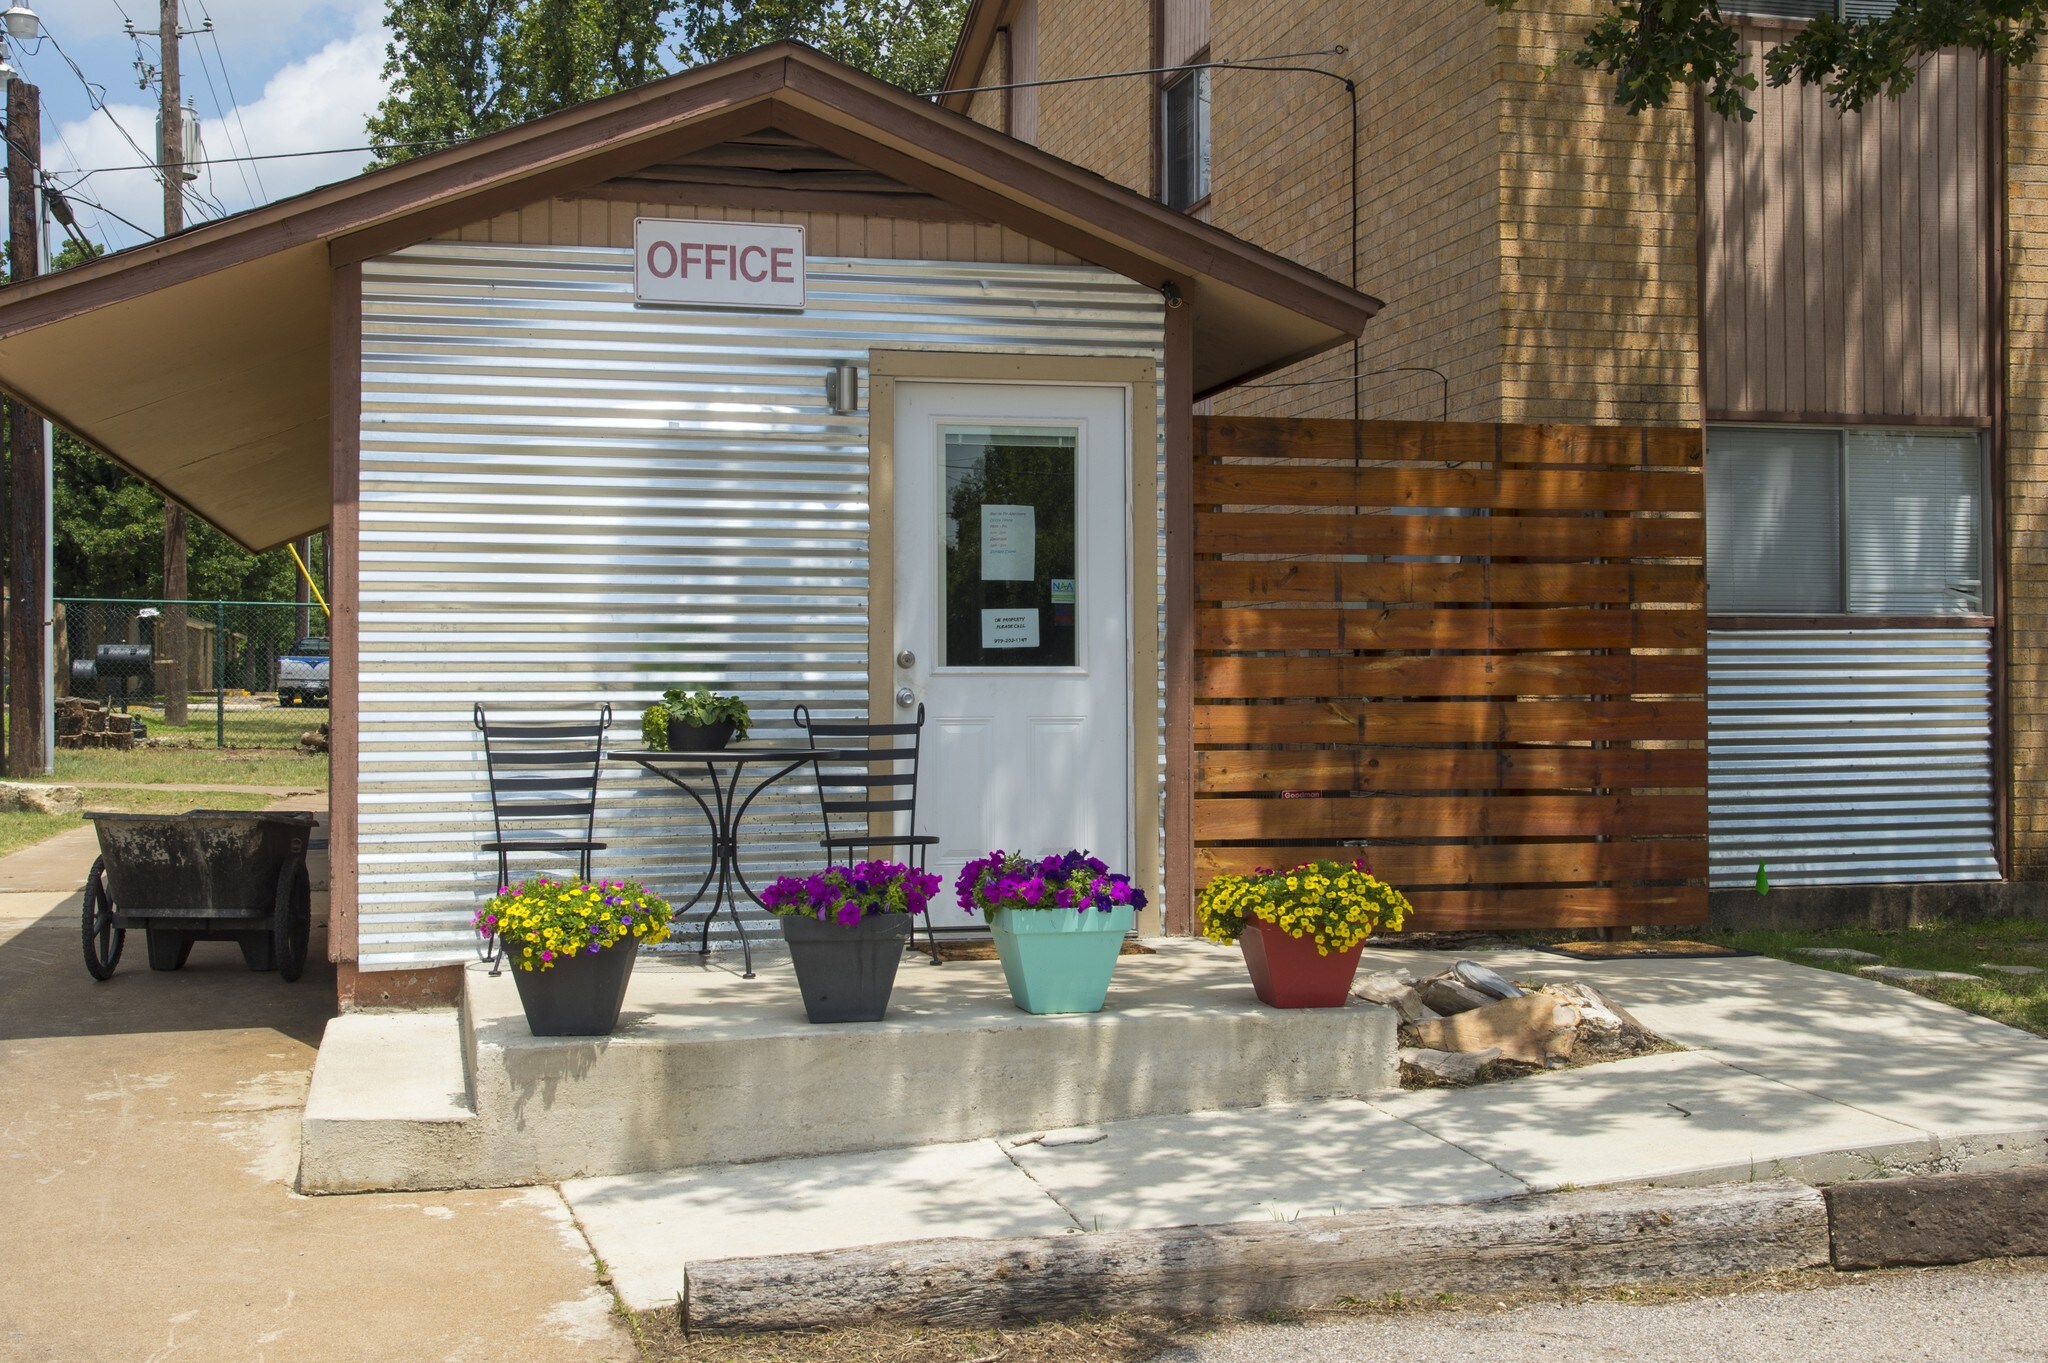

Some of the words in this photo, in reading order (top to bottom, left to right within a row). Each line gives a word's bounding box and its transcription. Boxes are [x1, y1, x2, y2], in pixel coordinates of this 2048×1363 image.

[647, 240, 795, 283] OFFICE
[1053, 582, 1073, 591] NAA
[1284, 791, 1320, 799] Goodman
